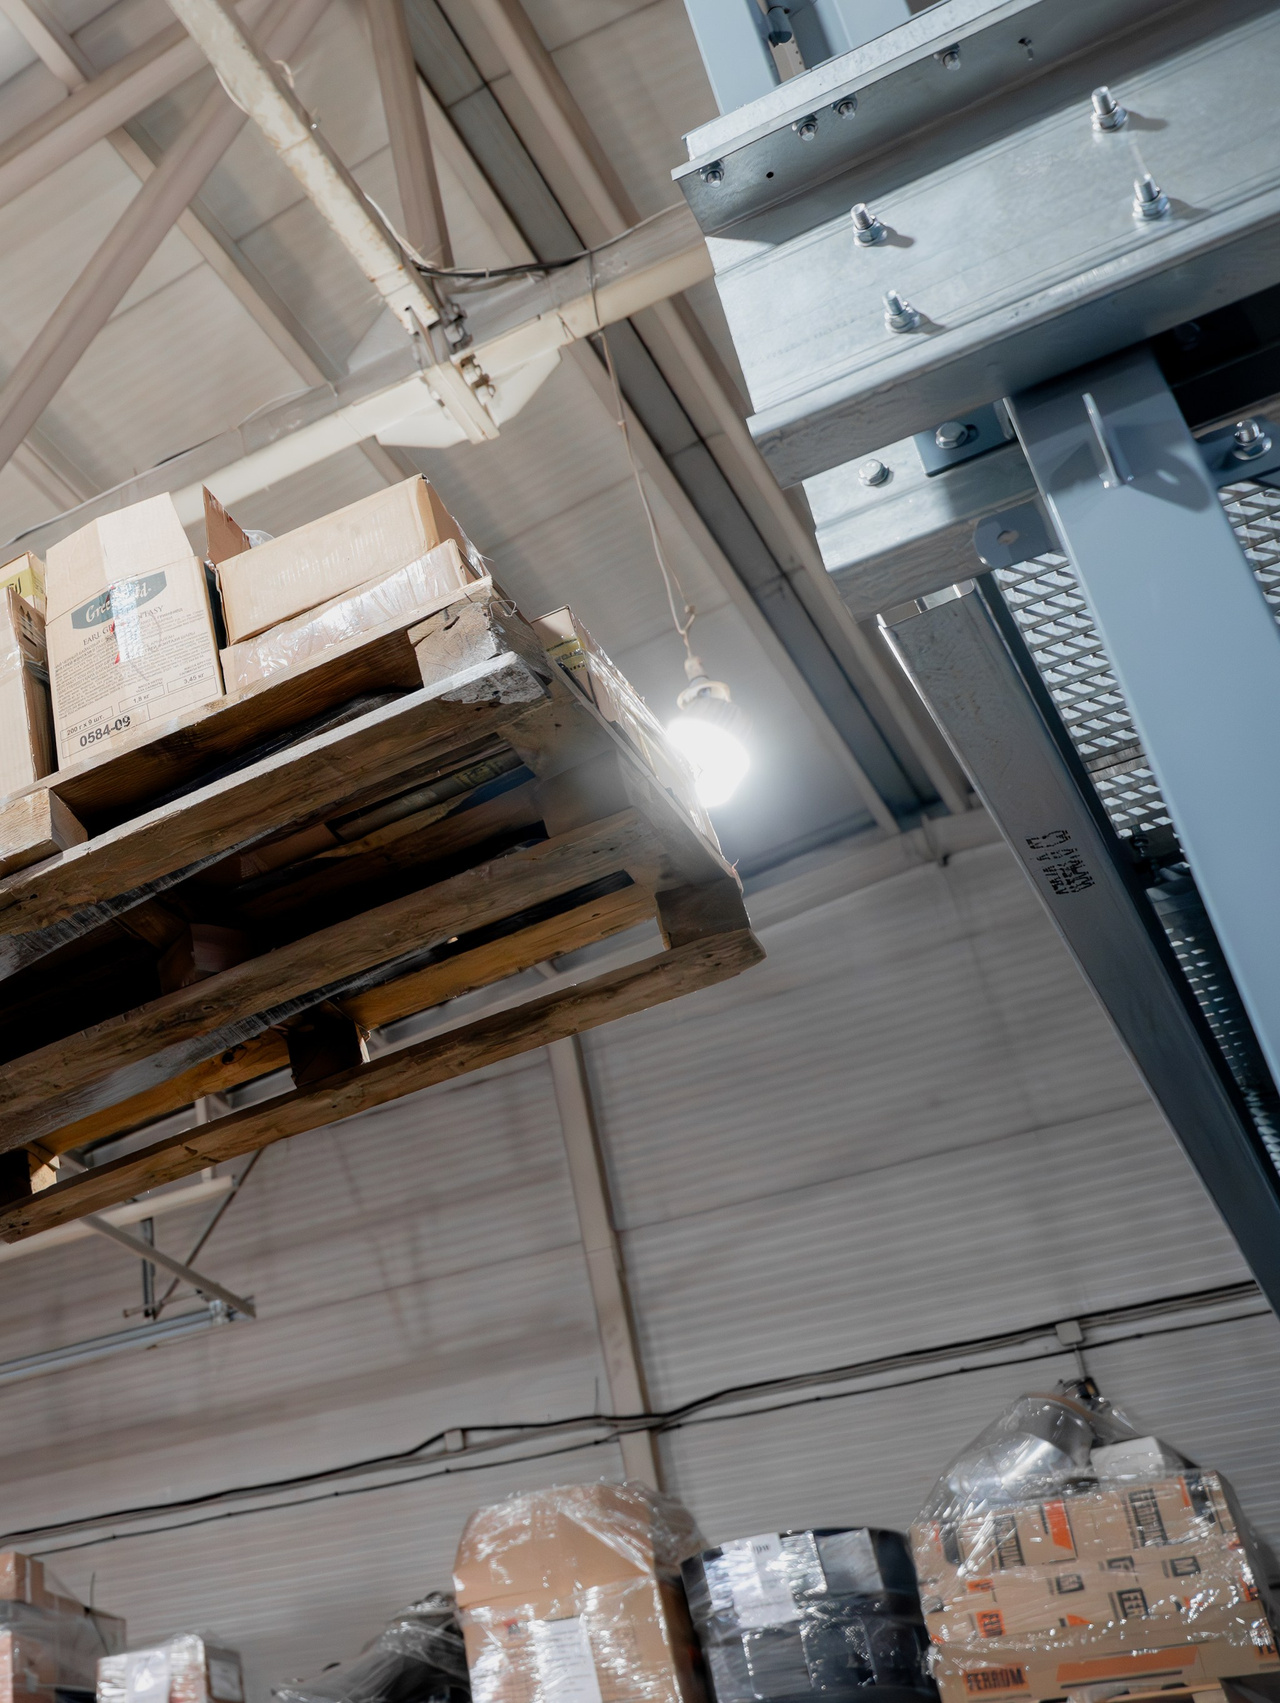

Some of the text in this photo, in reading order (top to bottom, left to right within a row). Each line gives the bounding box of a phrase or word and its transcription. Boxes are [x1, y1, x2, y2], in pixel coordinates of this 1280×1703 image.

[83, 631, 101, 645] EARL
[66, 726, 78, 736] 200
[80, 715, 131, 747] 0584-09
[967, 1667, 1024, 1691] FERRUM
